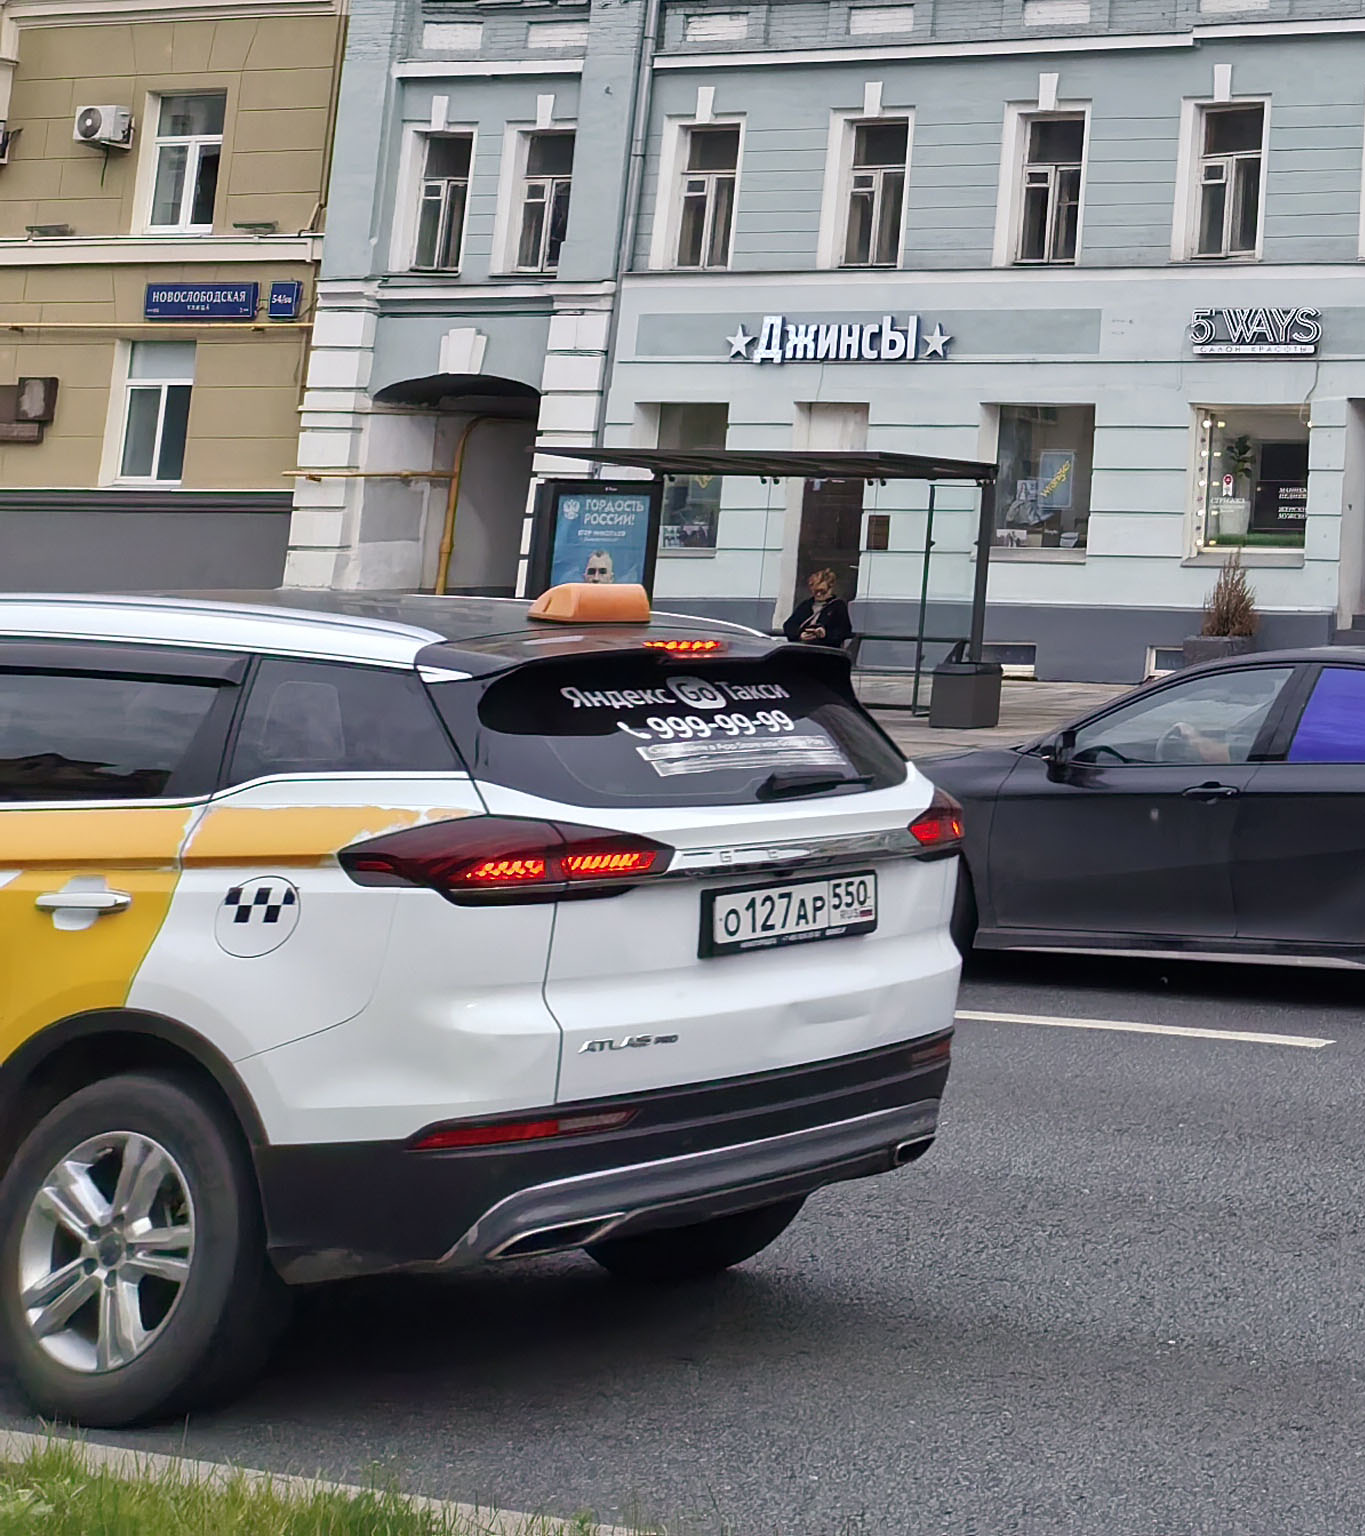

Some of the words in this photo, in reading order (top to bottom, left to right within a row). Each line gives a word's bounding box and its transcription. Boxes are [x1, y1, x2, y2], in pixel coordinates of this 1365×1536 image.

[152, 291, 246, 303] НОВОСЛОБОДСКАЯ
[1190, 308, 1216, 344] 5
[1222, 307, 1322, 344] WAYS
[585, 499, 645, 512] ГОРДОСТЬ
[584, 513, 636, 525] РОССИИ!
[560, 686, 676, 710] Яндекс
[714, 681, 791, 701] Такси
[646, 709, 795, 740] 999-99-99
[724, 892, 826, 937] О127АР
[832, 879, 868, 910] 550
